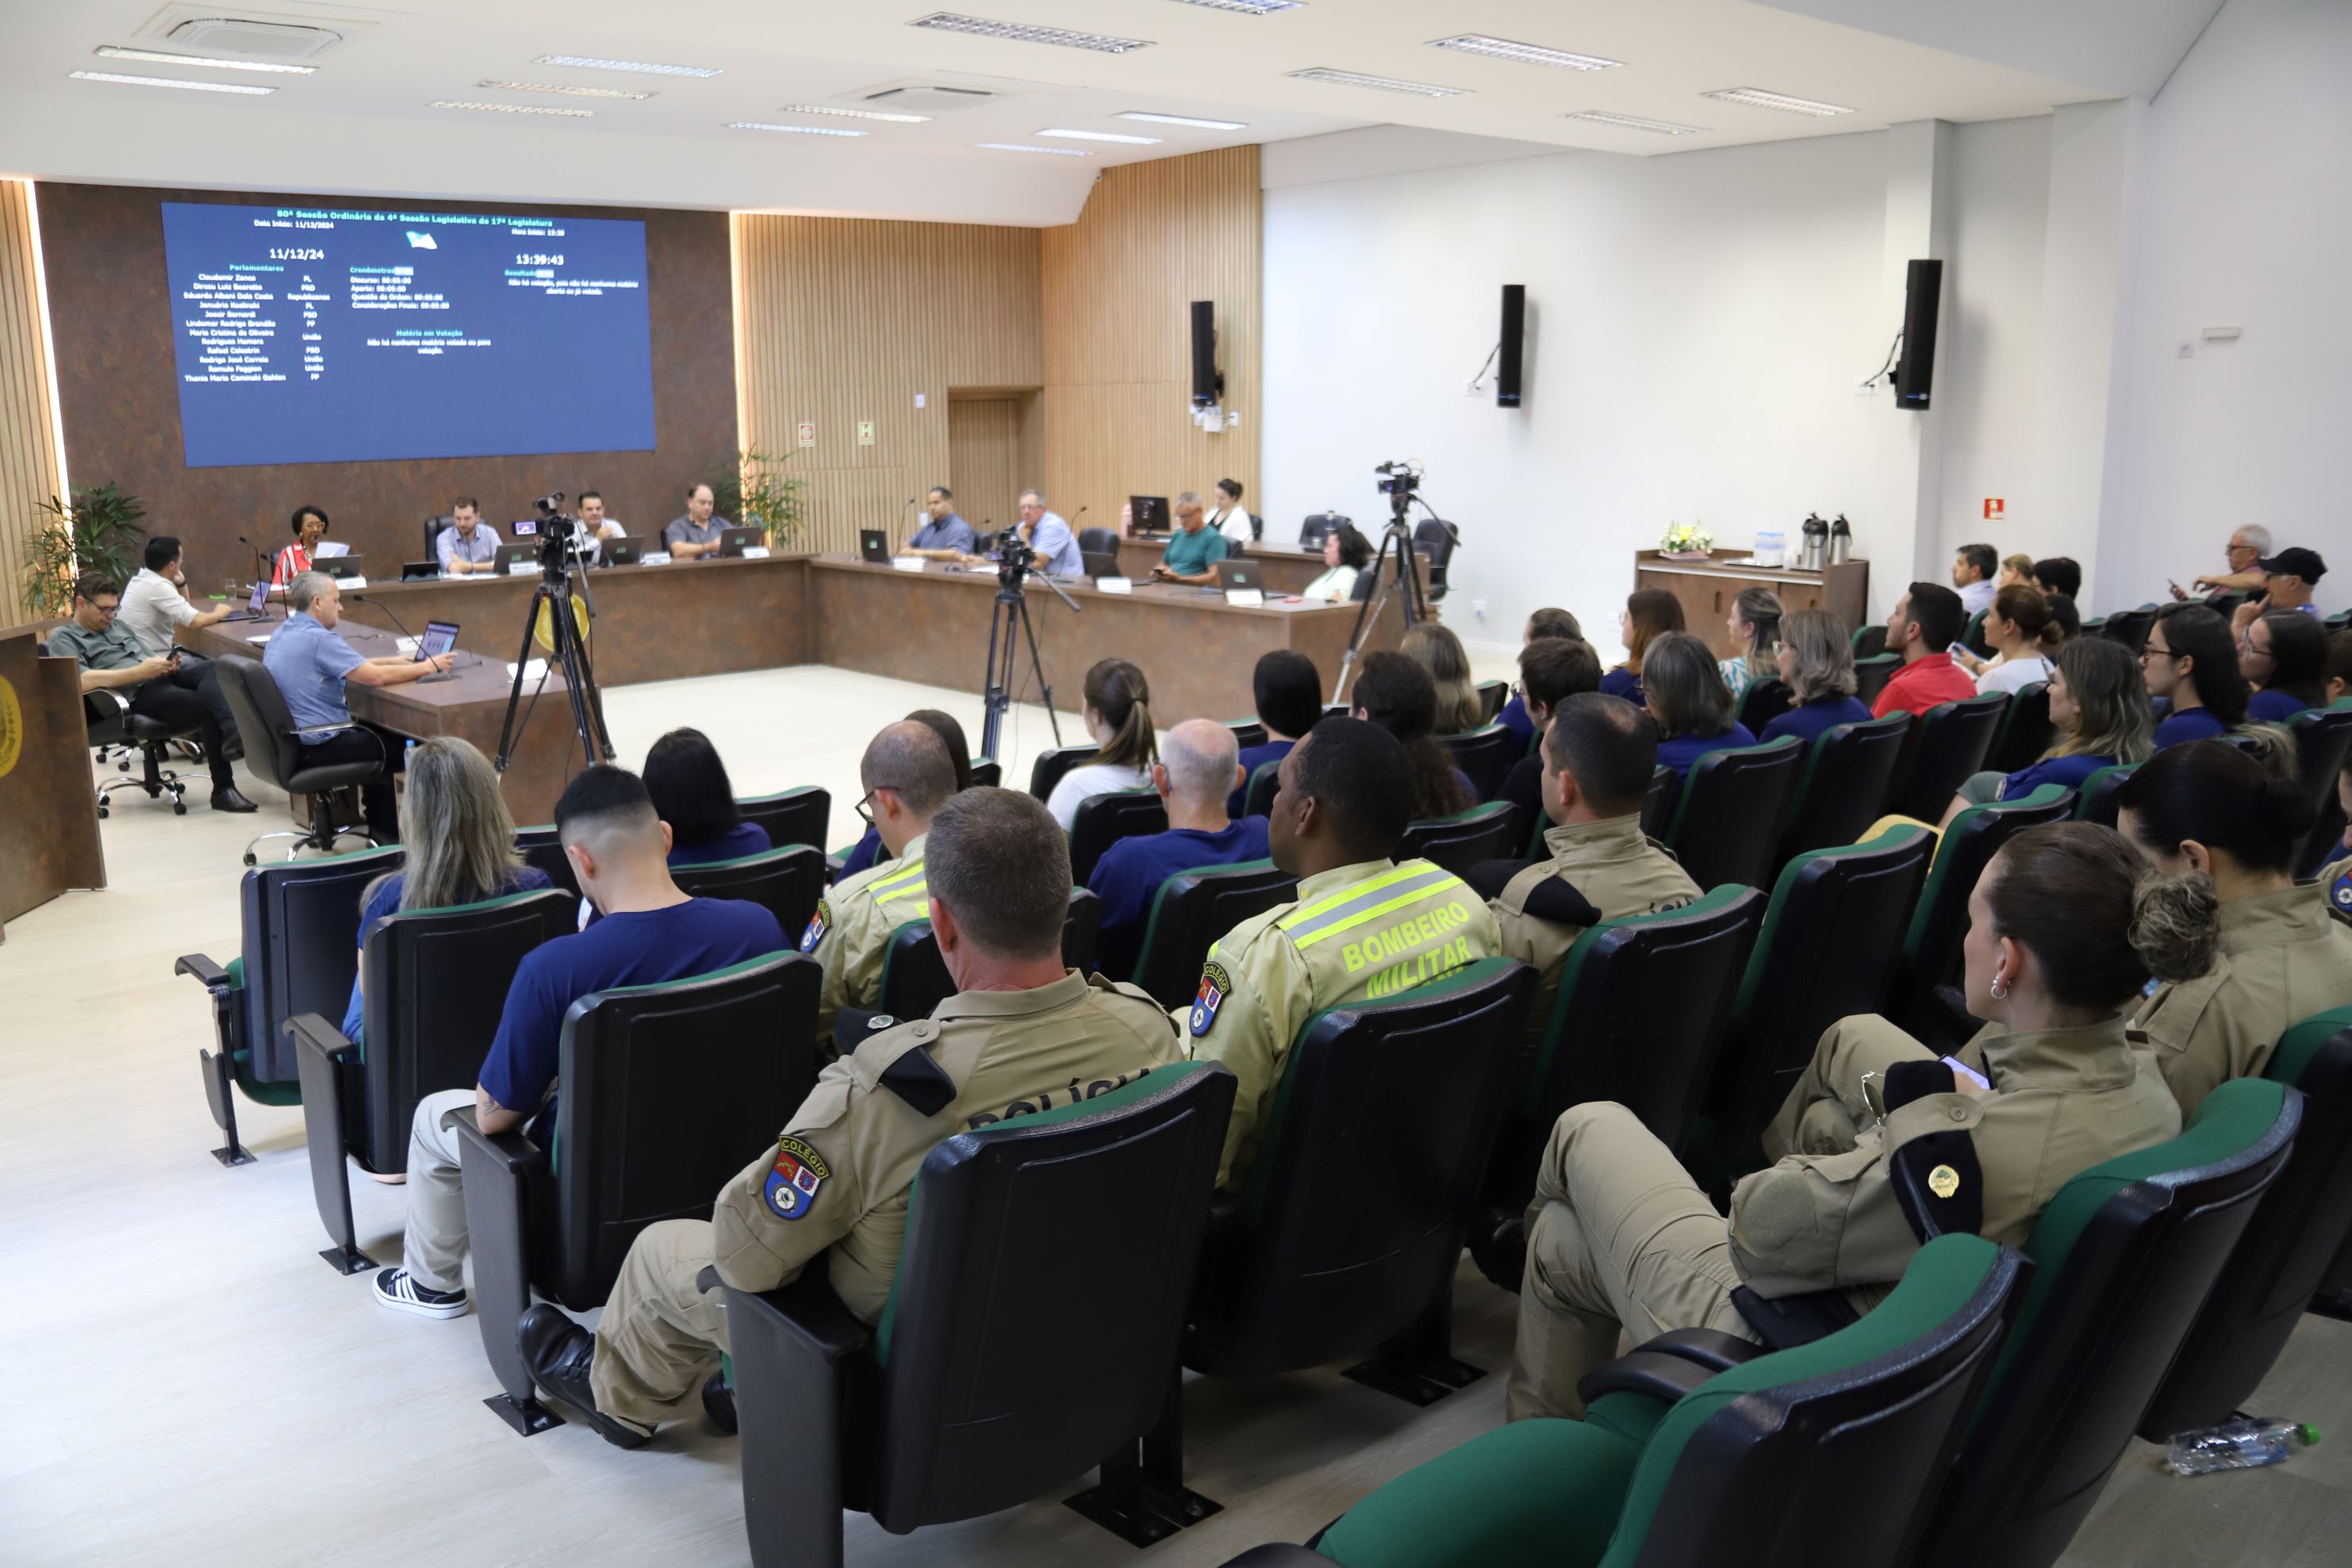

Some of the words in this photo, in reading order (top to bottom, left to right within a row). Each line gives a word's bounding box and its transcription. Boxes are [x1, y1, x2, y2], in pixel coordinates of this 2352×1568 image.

[254, 219, 270, 228] Data
[295, 221, 334, 230] 11/12/2024
[296, 210, 328, 220] Sessão
[330, 211, 372, 220] Ordinária
[374, 213, 385, 221] da
[399, 214, 430, 223] Sessão
[432, 216, 477, 226] Legislativa
[508, 218, 553, 228] Legislatura
[270, 248, 324, 260] 11/12/24
[516, 254, 565, 266] 13:39:43
[287, 293, 330, 301] Republicanos
[1342, 901, 1469, 973] BOMBEIRO
[1367, 936, 1472, 999] MILITAR
[1205, 965, 1227, 991] COLÉGIO
[782, 1139, 826, 1175] COLÉGIO
